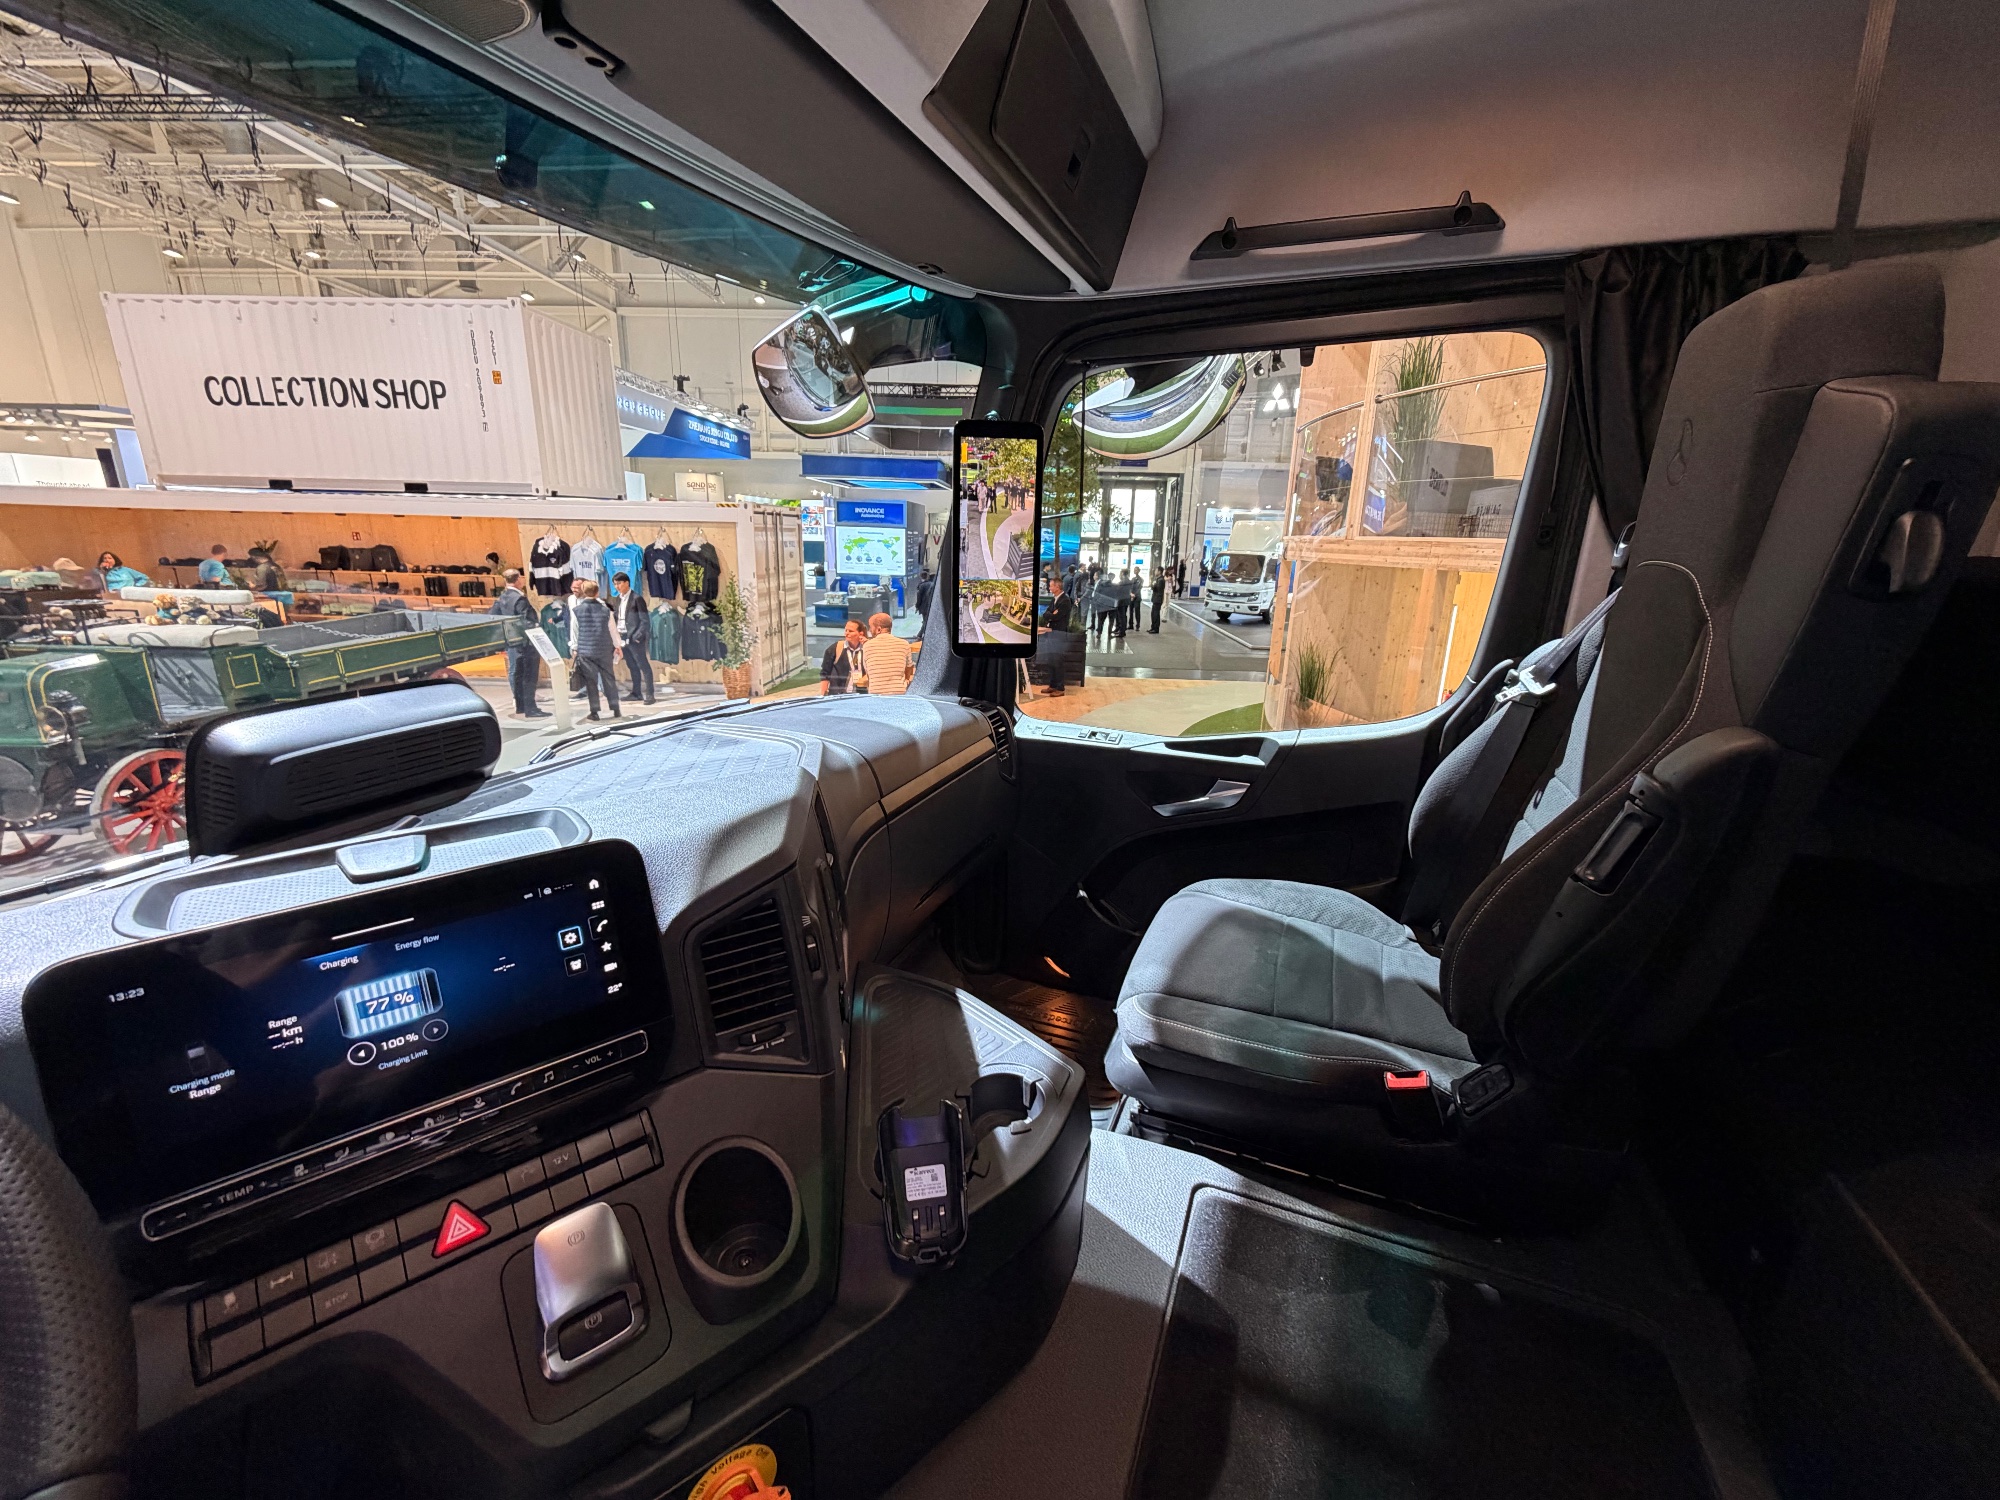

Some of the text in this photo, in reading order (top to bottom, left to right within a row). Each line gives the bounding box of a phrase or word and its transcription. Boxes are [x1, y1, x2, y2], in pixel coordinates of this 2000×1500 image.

[203, 375, 447, 410] COLLECTION SHOP
[395, 934, 440, 952] Energy flow
[319, 955, 359, 971] Charging
[108, 987, 145, 1003] 13:23
[365, 991, 415, 1014] 77 %
[268, 1015, 298, 1030] Range
[282, 1025, 303, 1038] km
[381, 1032, 419, 1051] 100 %
[378, 1048, 429, 1071] Charging Limit
[584, 1055, 602, 1065] VOL
[168, 1068, 236, 1095] Charging mode
[188, 1083, 222, 1099] Range
[217, 1184, 254, 1204] TEMP
[711, 1449, 752, 1475] Voltage
